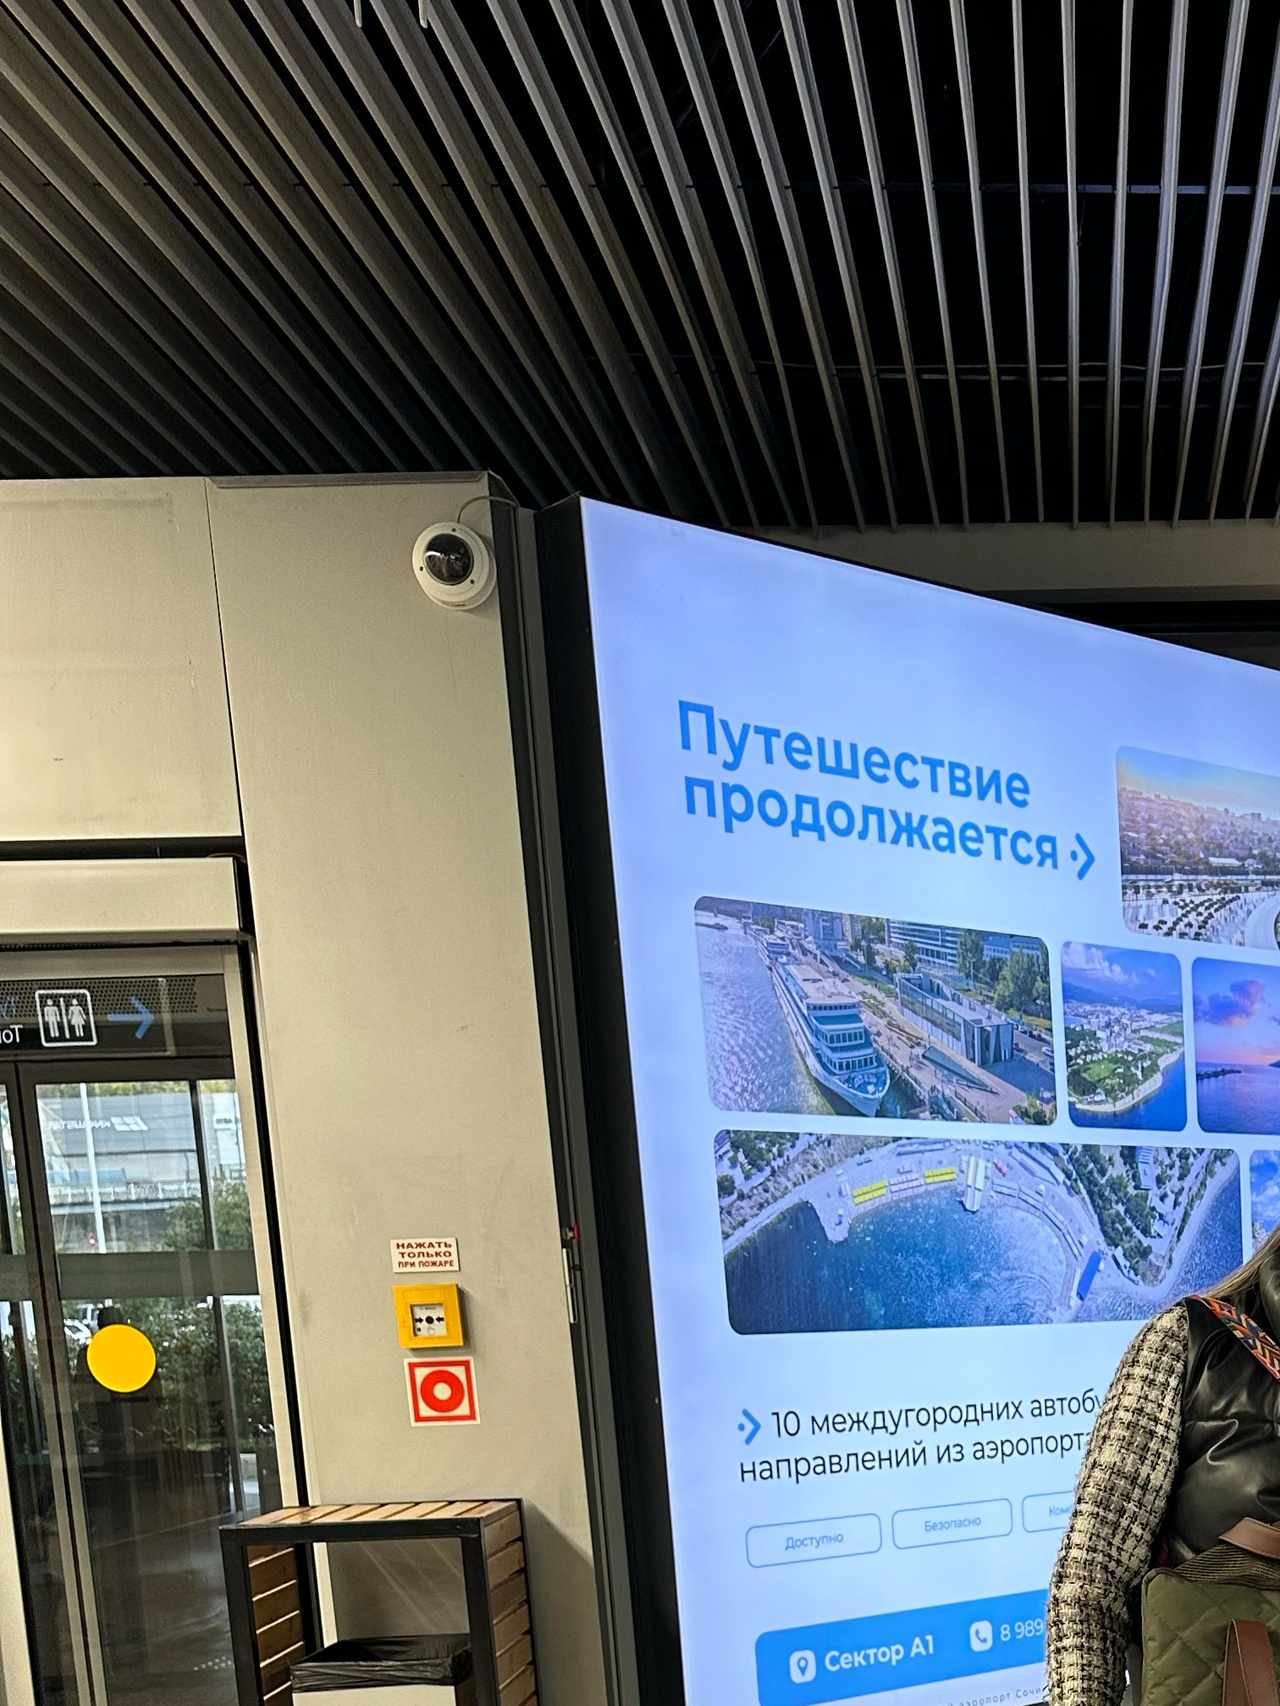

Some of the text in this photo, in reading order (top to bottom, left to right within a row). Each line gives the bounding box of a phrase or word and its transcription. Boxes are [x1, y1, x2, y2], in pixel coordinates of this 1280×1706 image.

[678, 699, 1031, 809] Путешествие
[684, 775, 1059, 870] продолжается
[396, 1241, 452, 1250] НАЖАТЬ
[398, 1250, 452, 1259] ТОЛЬКО
[418, 1260, 455, 1268] ПОЖАРЕ
[771, 1409, 801, 1438] 10
[810, 1399, 1024, 1436] междугородних
[740, 1431, 1091, 1484] направлений из аэропорт
[924, 1515, 982, 1533] Безопасно
[785, 1532, 844, 1551] Доступно
[1000, 1618, 1044, 1641] 8 989
[824, 1642, 905, 1672] Сектор
